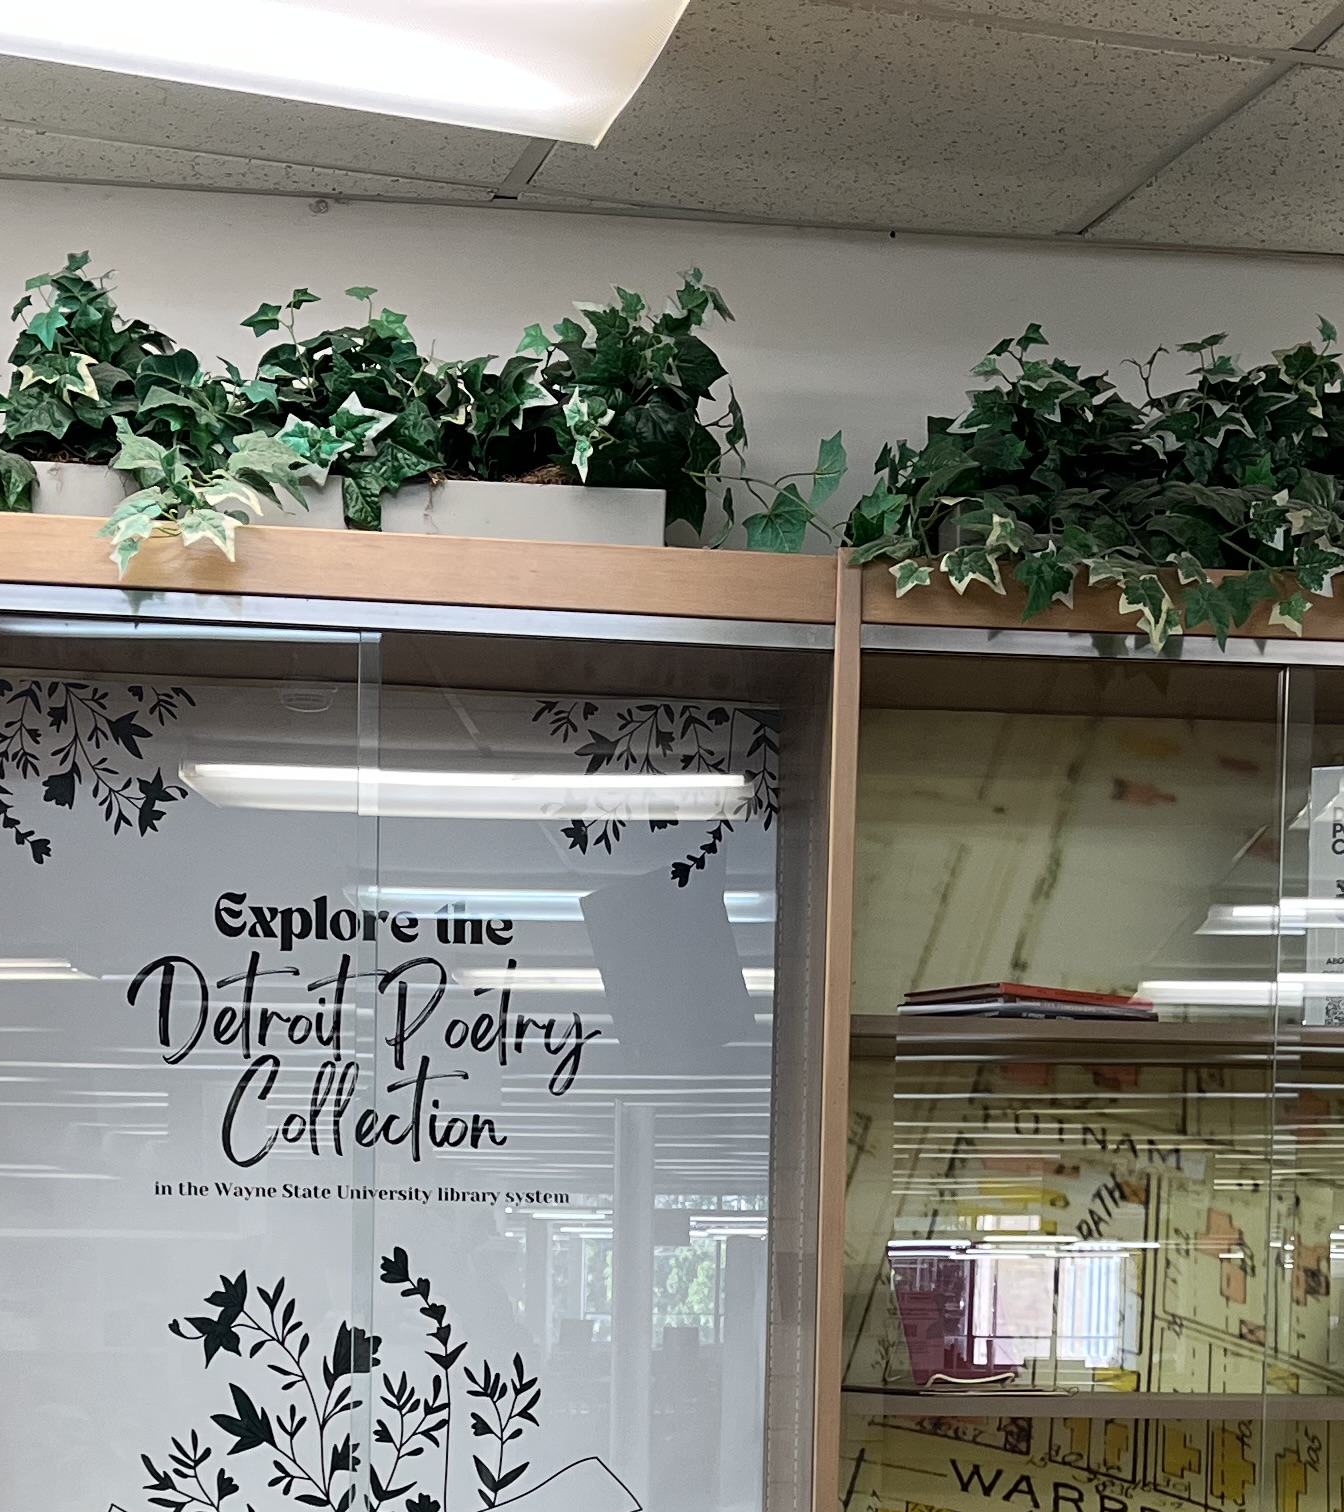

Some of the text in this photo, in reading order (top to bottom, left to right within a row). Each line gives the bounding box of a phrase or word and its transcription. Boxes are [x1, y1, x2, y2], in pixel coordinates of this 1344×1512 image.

[214, 891, 514, 951] Explore the
[126, 951, 603, 1096] Detroit Poetry
[222, 1054, 508, 1169] Collection
[154, 1181, 570, 1206] in the Wayne State University library system
